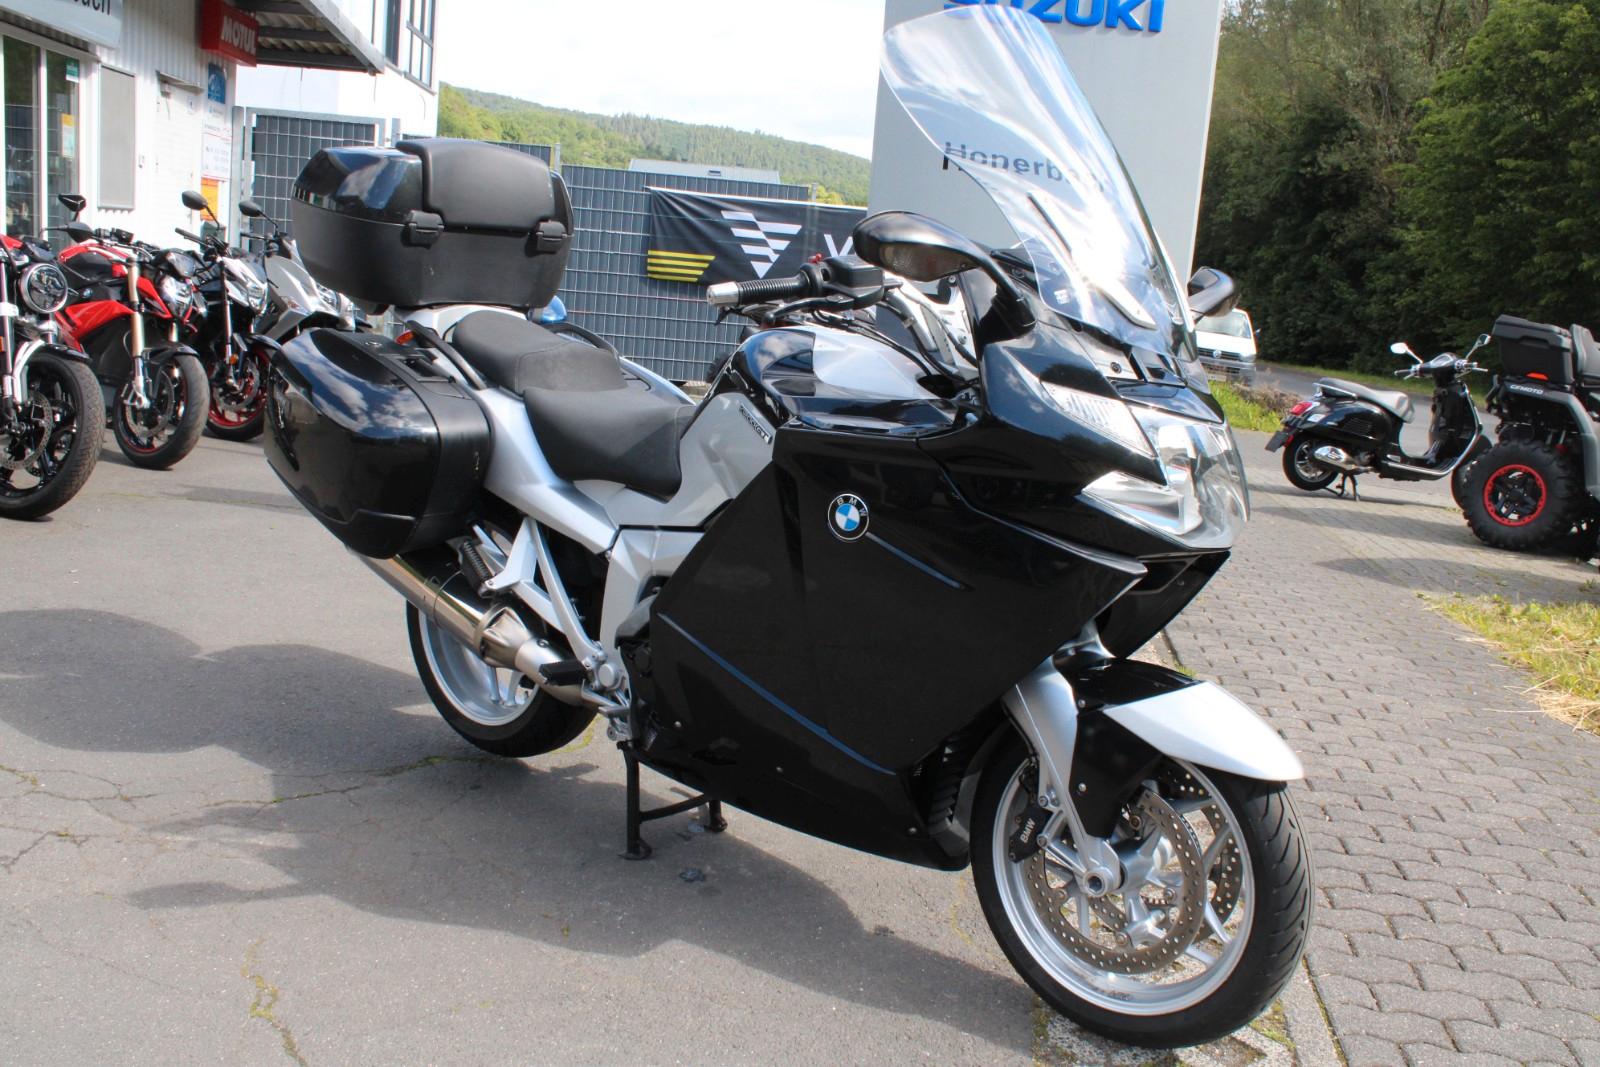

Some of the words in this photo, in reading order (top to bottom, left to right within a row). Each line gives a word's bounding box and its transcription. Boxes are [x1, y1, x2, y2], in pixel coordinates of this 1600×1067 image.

[943, 0, 1165, 33] ZUKI
[220, 15, 256, 56] MOTUL
[836, 497, 868, 516] BMW
[1020, 817, 1036, 843] BMW
